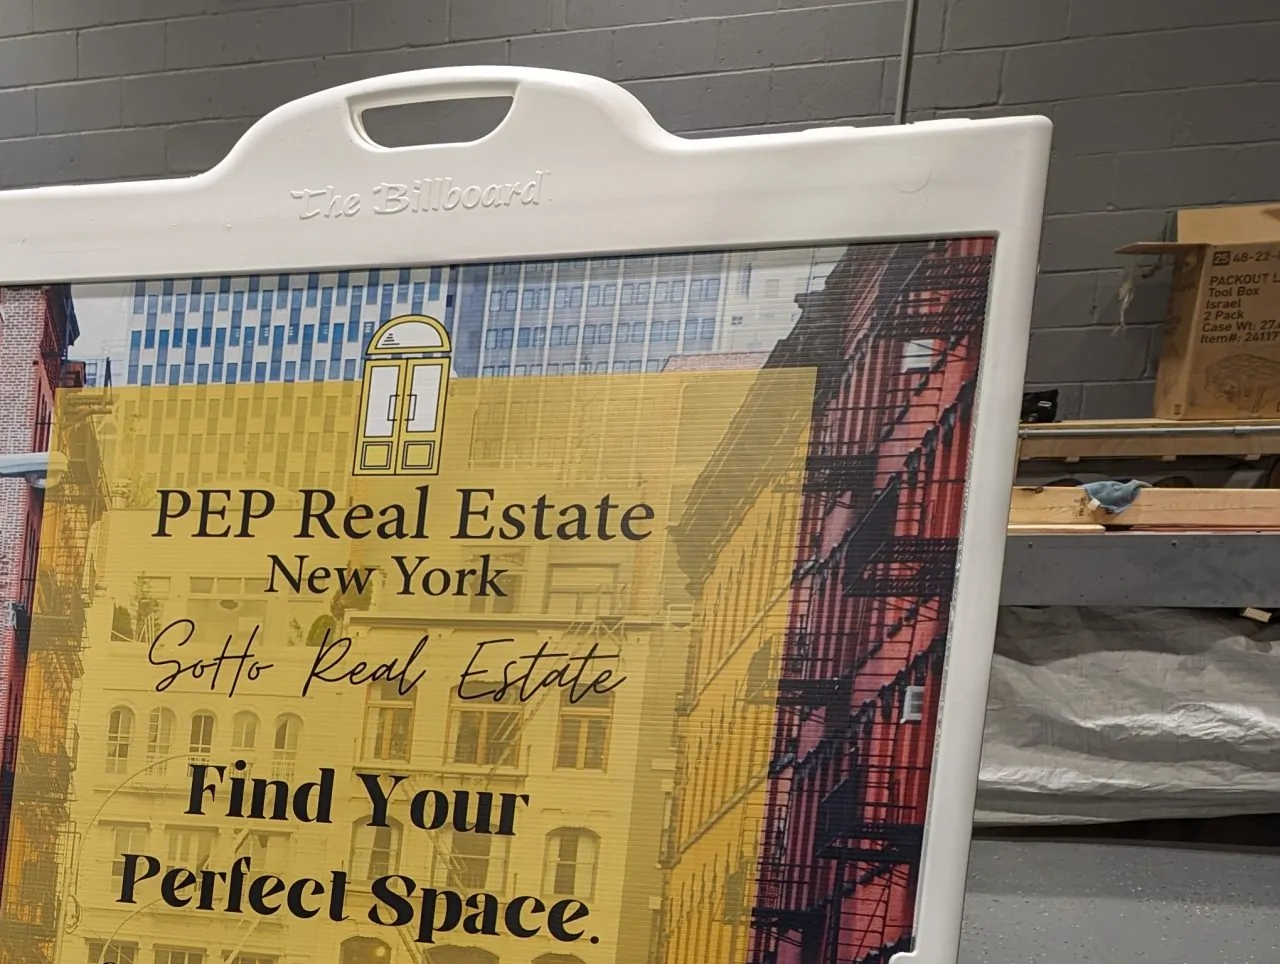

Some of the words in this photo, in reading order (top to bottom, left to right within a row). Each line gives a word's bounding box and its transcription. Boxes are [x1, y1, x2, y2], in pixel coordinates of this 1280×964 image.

[289, 185, 361, 220] The
[373, 170, 543, 215] Billboard
[1208, 287, 1233, 298] Tool
[1236, 286, 1260, 297] Box
[1209, 273, 1269, 285] PACKOUT
[1204, 311, 1212, 321] 2
[1215, 310, 1245, 321] Pack
[1206, 299, 1242, 309] Israel
[1202, 322, 1232, 333] Case
[151, 488, 276, 539] PEP
[293, 485, 429, 541] Real
[449, 488, 656, 542] Estate
[264, 553, 376, 595] New
[392, 552, 509, 598] York
[147, 619, 274, 698] SoHo
[302, 628, 430, 698] Real
[457, 638, 627, 704] Estate
[184, 760, 335, 824] Find
[355, 772, 530, 837] Your
[115, 852, 350, 922] Perfect
[367, 873, 600, 944] Space.
